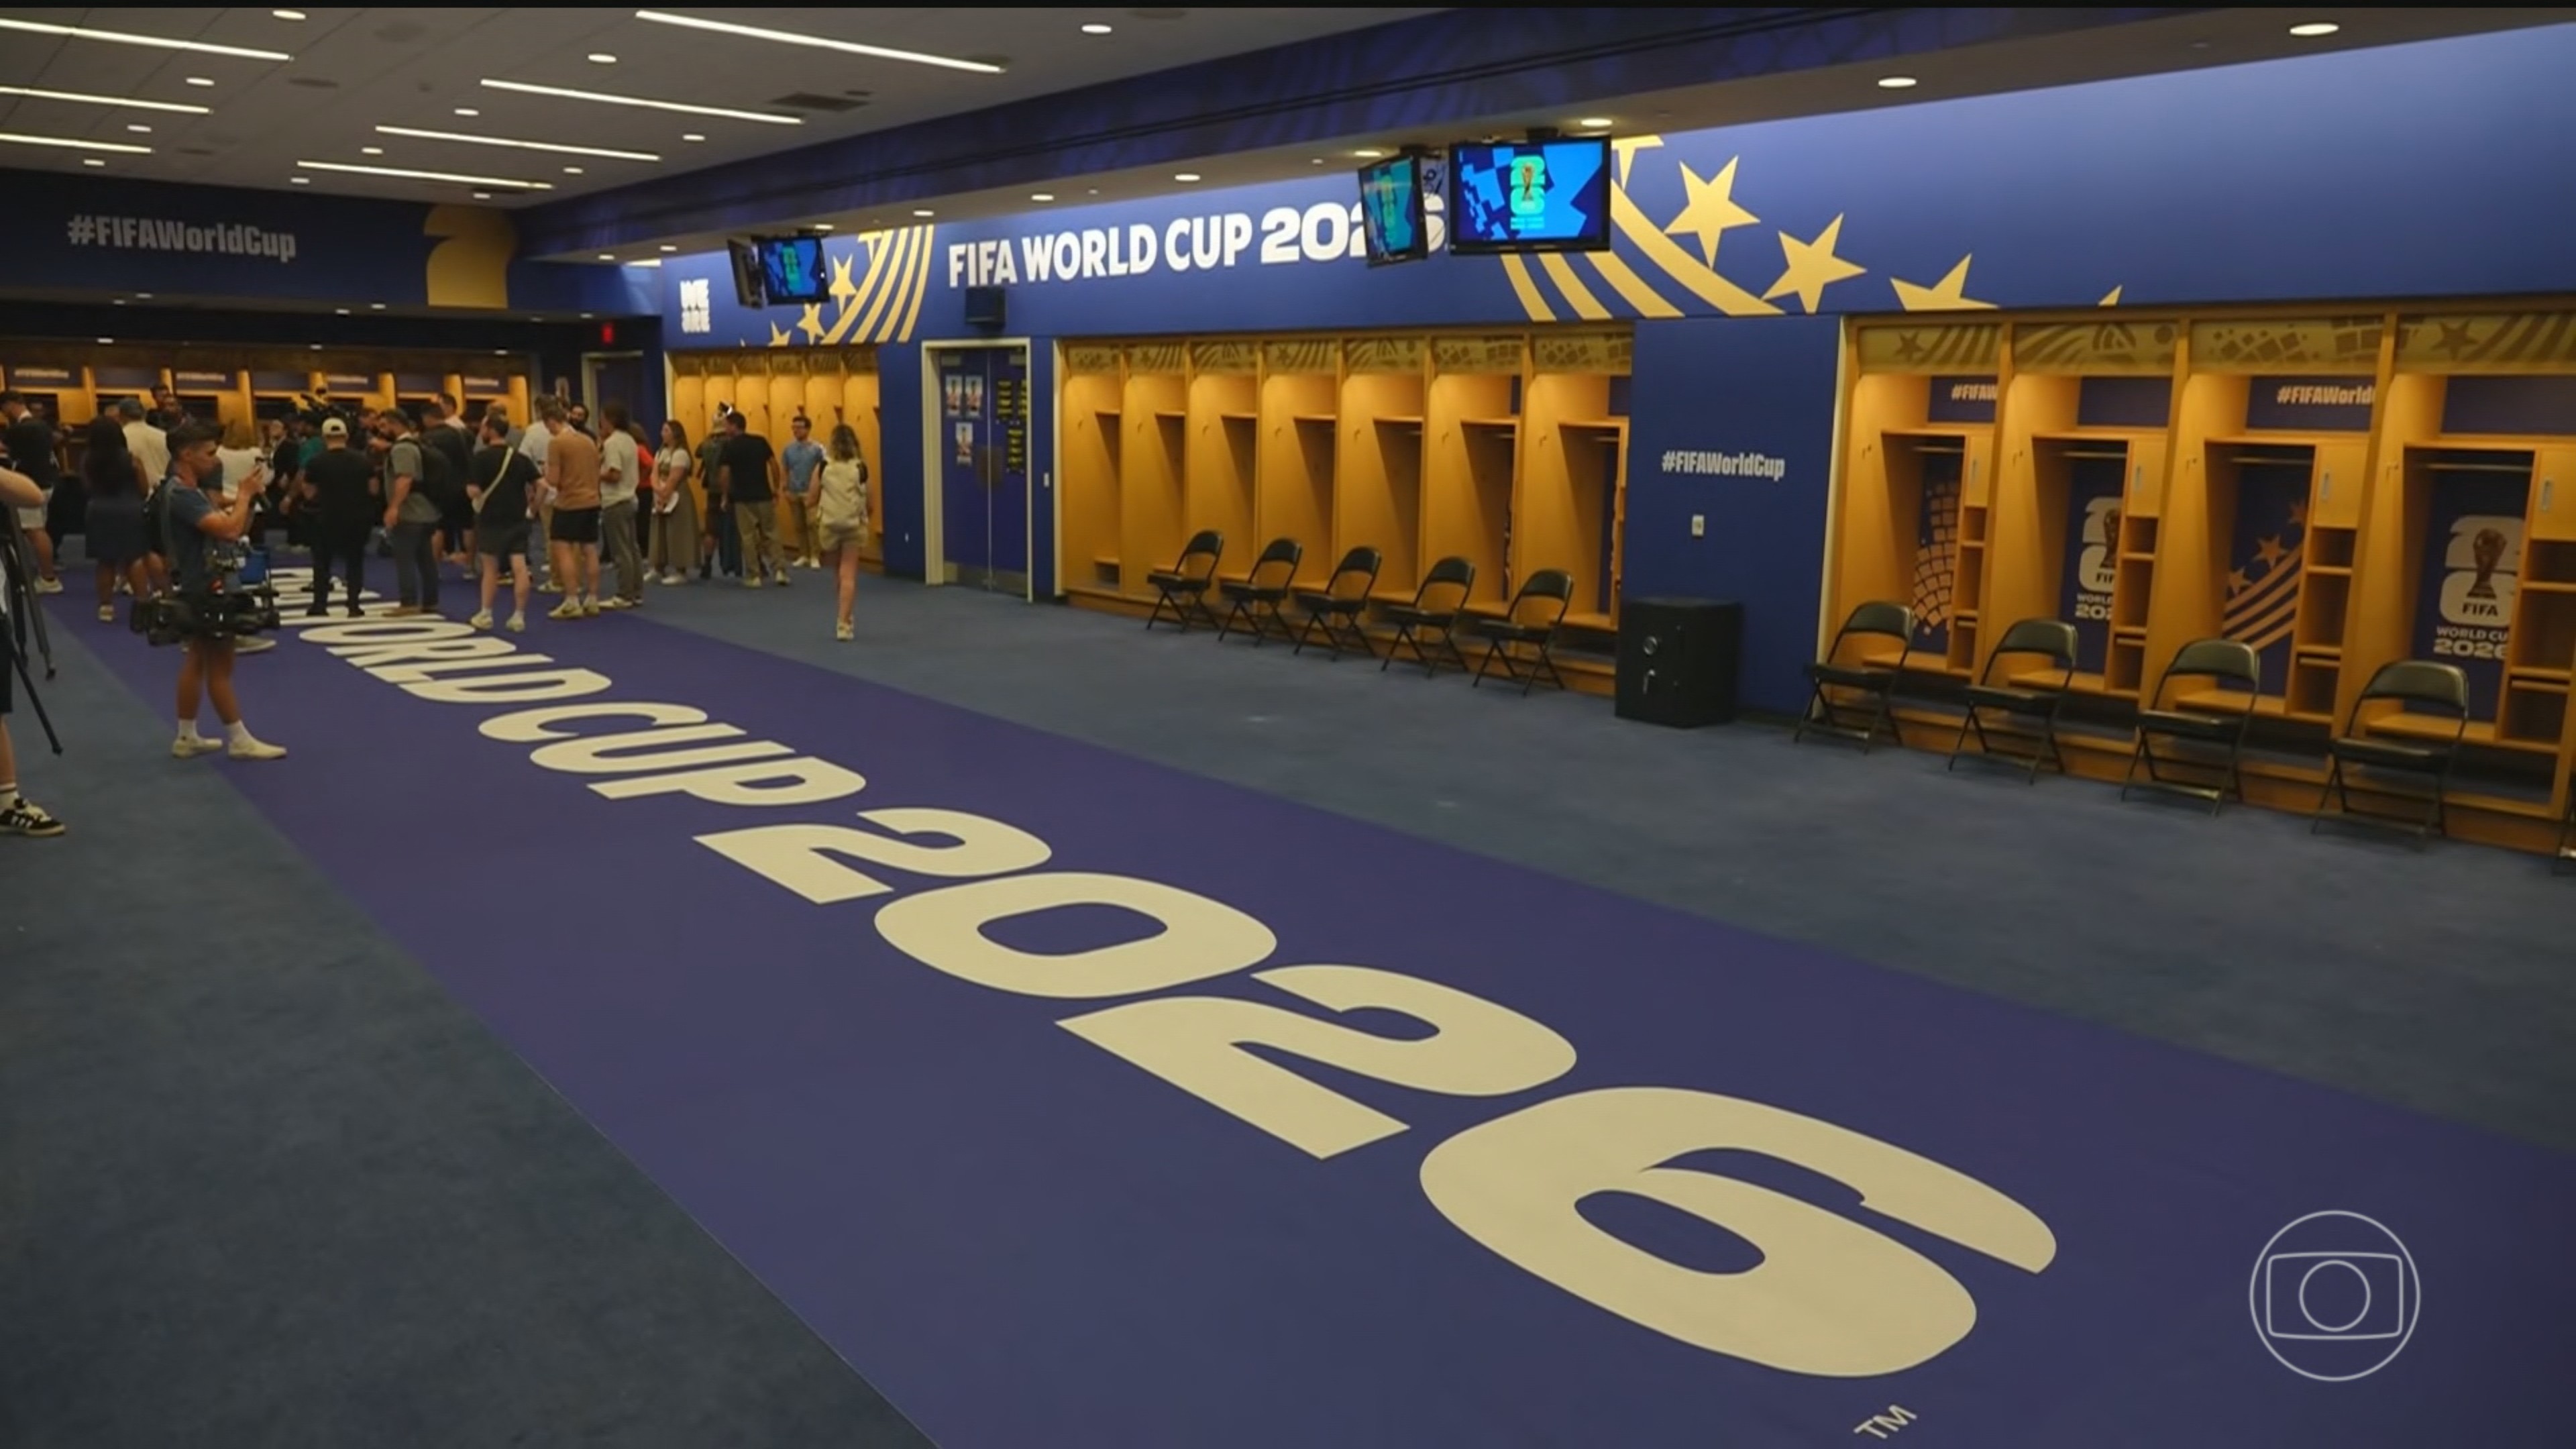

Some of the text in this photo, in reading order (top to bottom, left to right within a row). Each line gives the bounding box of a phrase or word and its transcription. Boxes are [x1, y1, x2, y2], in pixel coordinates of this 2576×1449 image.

[68, 215, 297, 264] #FIFAWorldCup
[949, 238, 1018, 287] FIFA
[1022, 224, 1158, 282] WORLD
[1165, 213, 1253, 271] CUP
[2277, 385, 2375, 405] #FIFAWorld
[1662, 451, 1786, 482] #FIFAWorldCup
[2462, 603, 2498, 616] FIFA
[2436, 627, 2487, 640] WORLD
[478, 702, 867, 806] CUP
[694, 808, 2057, 1377] 2026
[1853, 1404, 1918, 1440] TM
